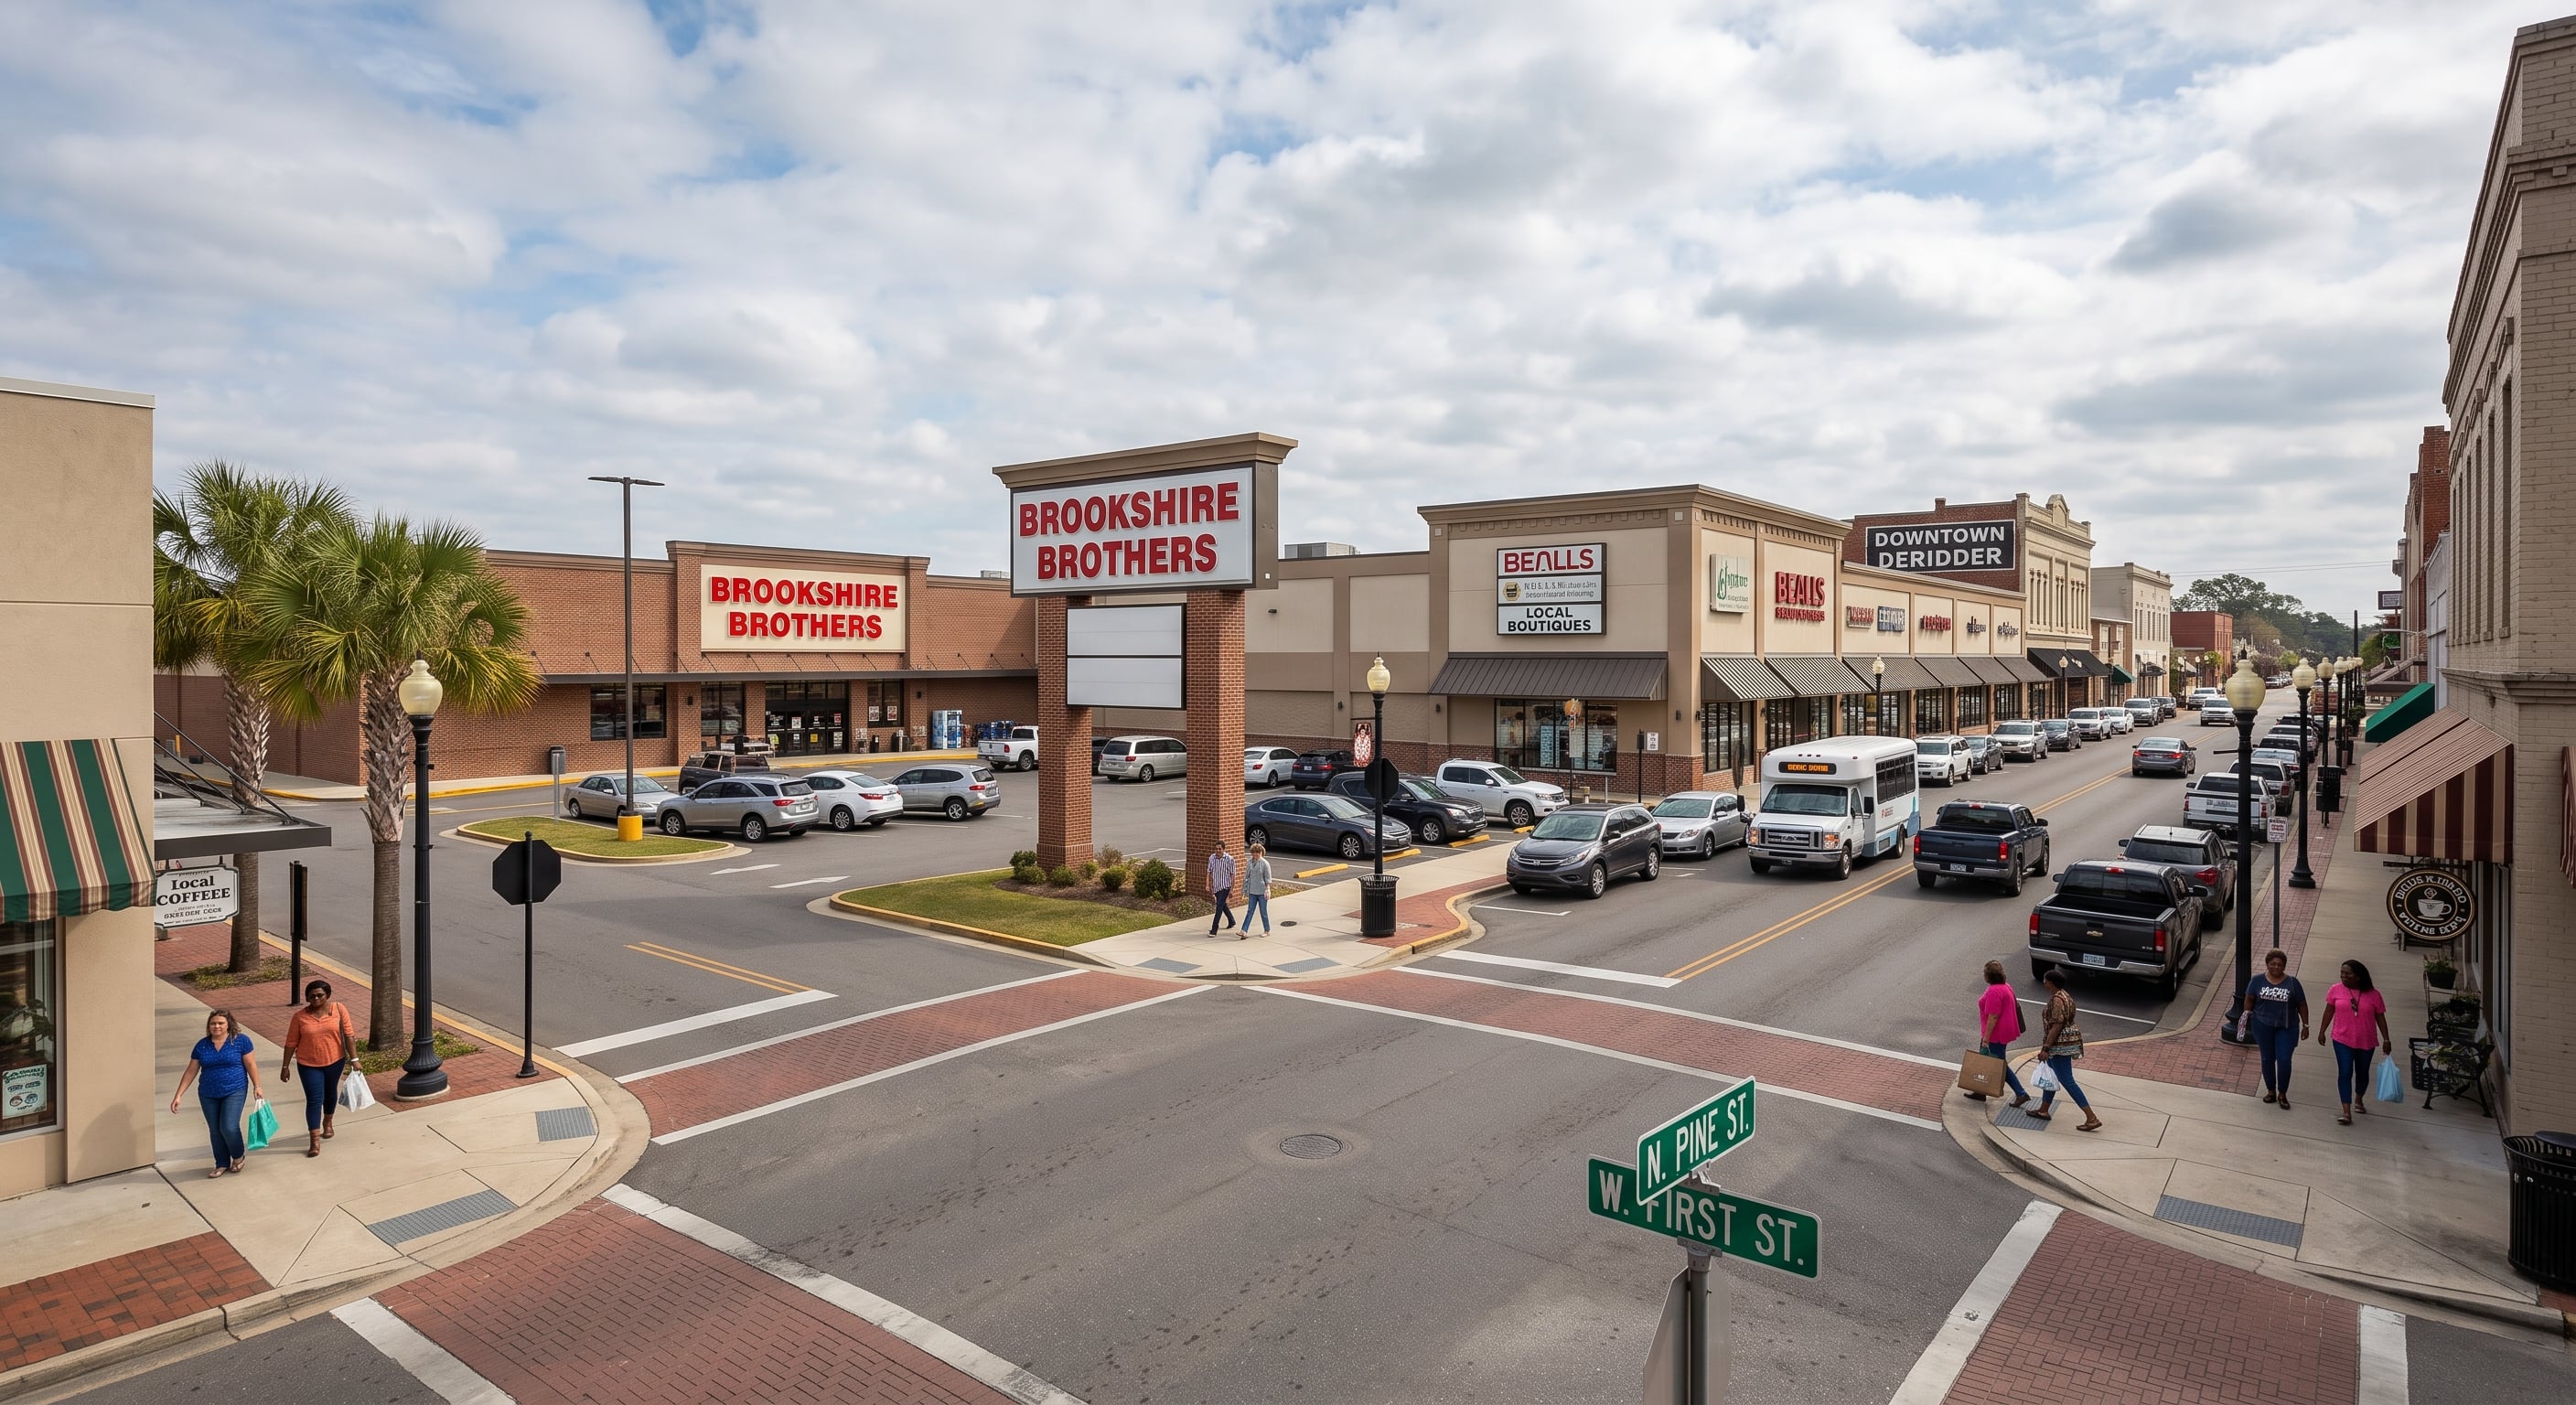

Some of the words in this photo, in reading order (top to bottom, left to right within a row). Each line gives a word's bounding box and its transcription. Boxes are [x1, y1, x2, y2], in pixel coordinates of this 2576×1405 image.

[1019, 481, 1240, 537] BROOKSHIRE
[1875, 526, 2004, 547] DOWNTOWN
[1037, 533, 1218, 580] BROTHERS
[1504, 549, 1594, 573] BEALLS
[1879, 548, 2002, 569] DERIDDER
[711, 576, 898, 608] BROOKSHIRE
[1775, 571, 1825, 606] BEALLS
[729, 611, 883, 639] BROTHERS
[1508, 619, 1592, 632] BOUTIQUES
[1526, 606, 1573, 618] LOCAL
[156, 887, 231, 906] COFFEEE
[1648, 1140, 1667, 1189] N.
[1676, 1108, 1719, 1172] PINE
[1727, 1092, 1749, 1141] ST.
[1599, 1169, 1629, 1216] W.
[1755, 1213, 1804, 1266] ST.
